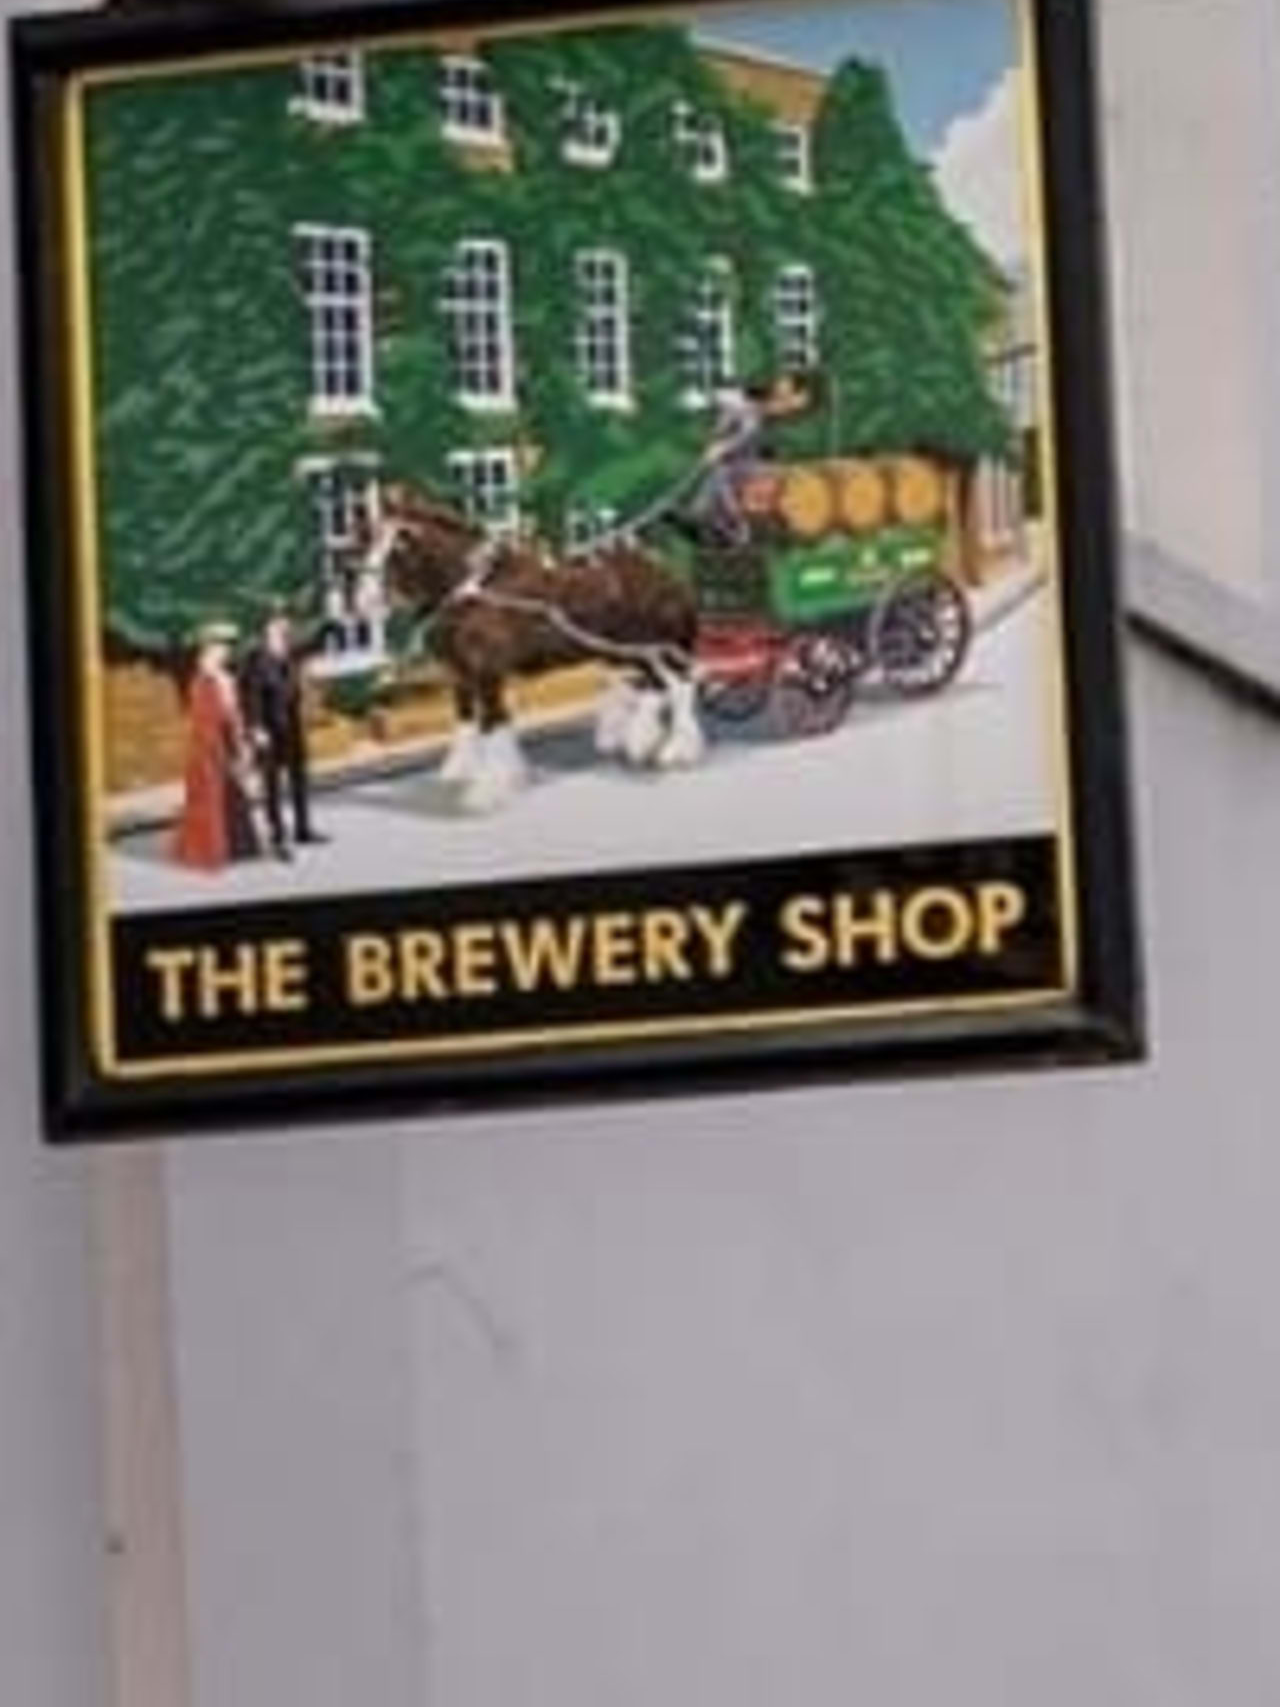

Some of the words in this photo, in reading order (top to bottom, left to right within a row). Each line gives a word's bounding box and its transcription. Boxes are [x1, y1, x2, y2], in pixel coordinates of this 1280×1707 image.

[146, 941, 306, 1018] THE
[346, 904, 745, 1004] BREWERY
[781, 882, 1025, 969] SHOP
